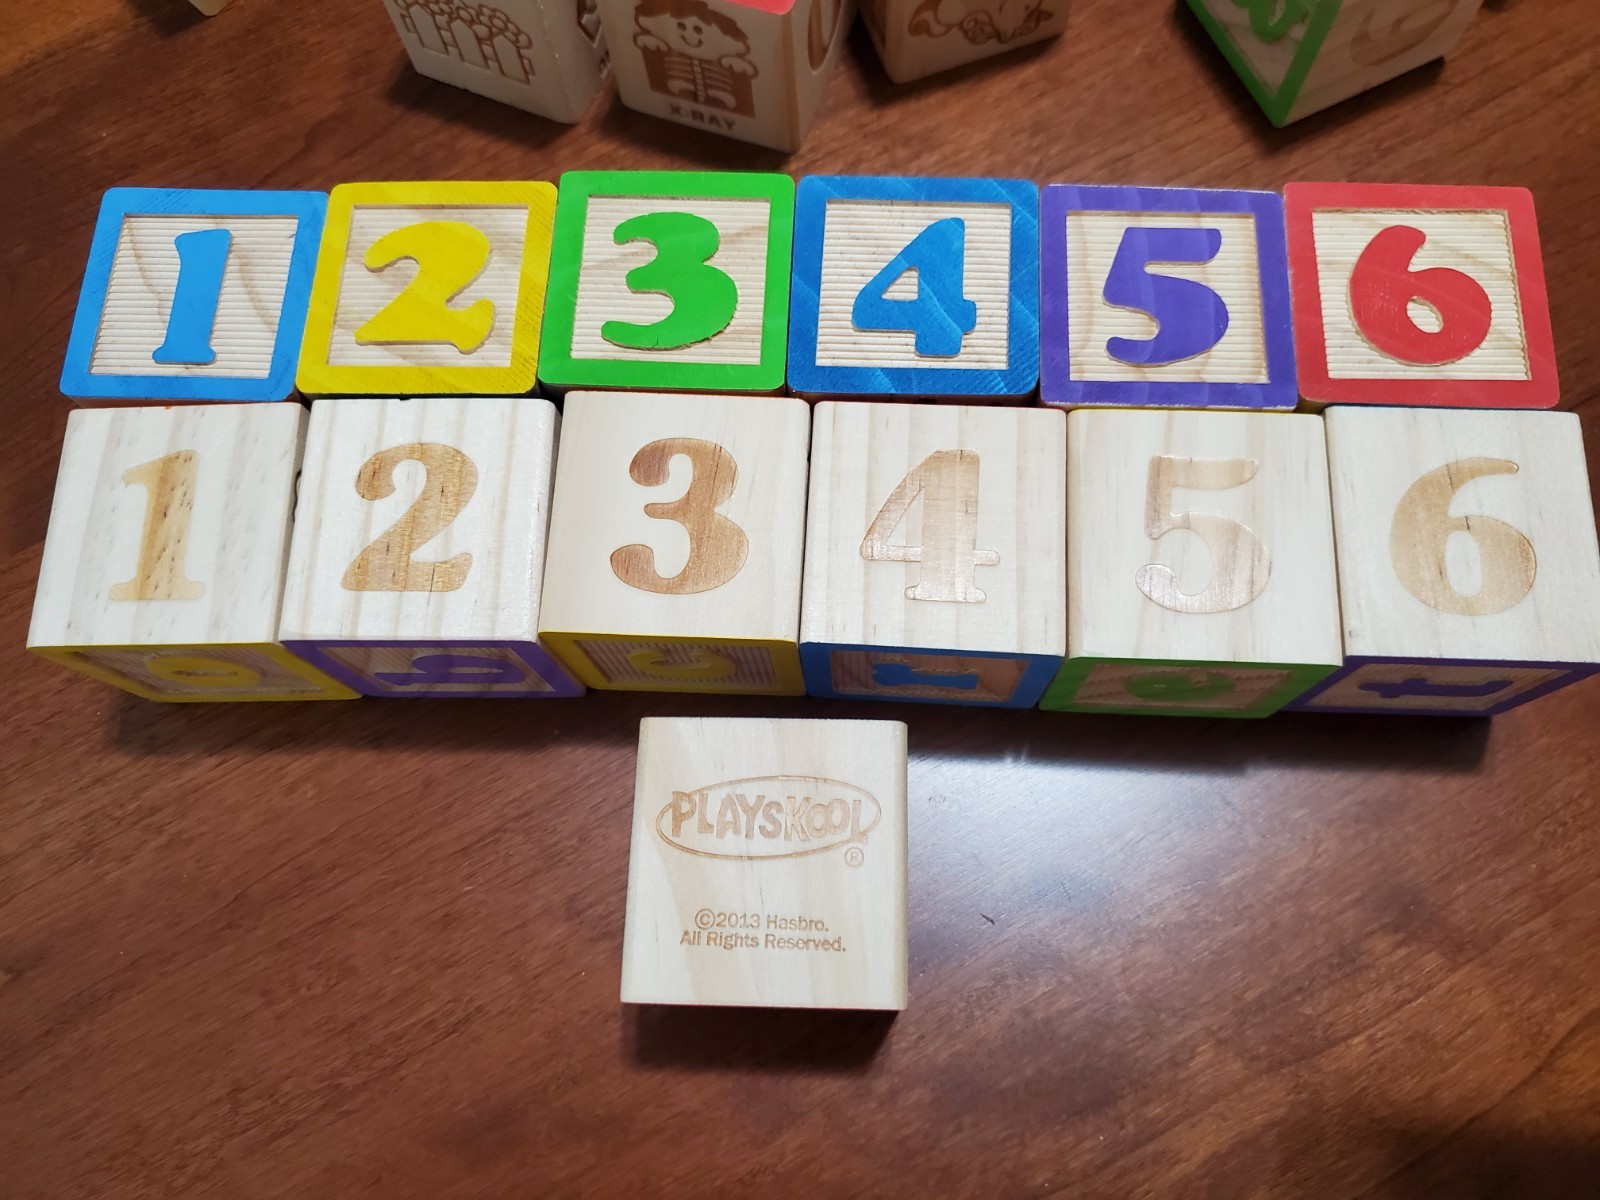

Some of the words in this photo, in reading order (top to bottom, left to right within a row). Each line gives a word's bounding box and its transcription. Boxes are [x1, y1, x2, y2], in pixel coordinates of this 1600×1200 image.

[153, 228, 232, 364] 1
[355, 221, 495, 353] 2
[602, 211, 739, 350] 3
[852, 217, 977, 358] 4
[1103, 227, 1230, 366] 5
[1349, 225, 1492, 365] 6
[108, 449, 206, 600] 1
[341, 443, 478, 592] 2
[610, 437, 749, 594] 3
[861, 449, 1000, 602] 4
[1135, 454, 1272, 614] 5
[1389, 456, 1537, 615] 6
[671, 790, 869, 845] PLAYSKOOL
[680, 929, 702, 946] All
[706, 931, 760, 951] Rights
[764, 933, 847, 952] Reserved.
[766, 914, 830, 932] Hasbro.
